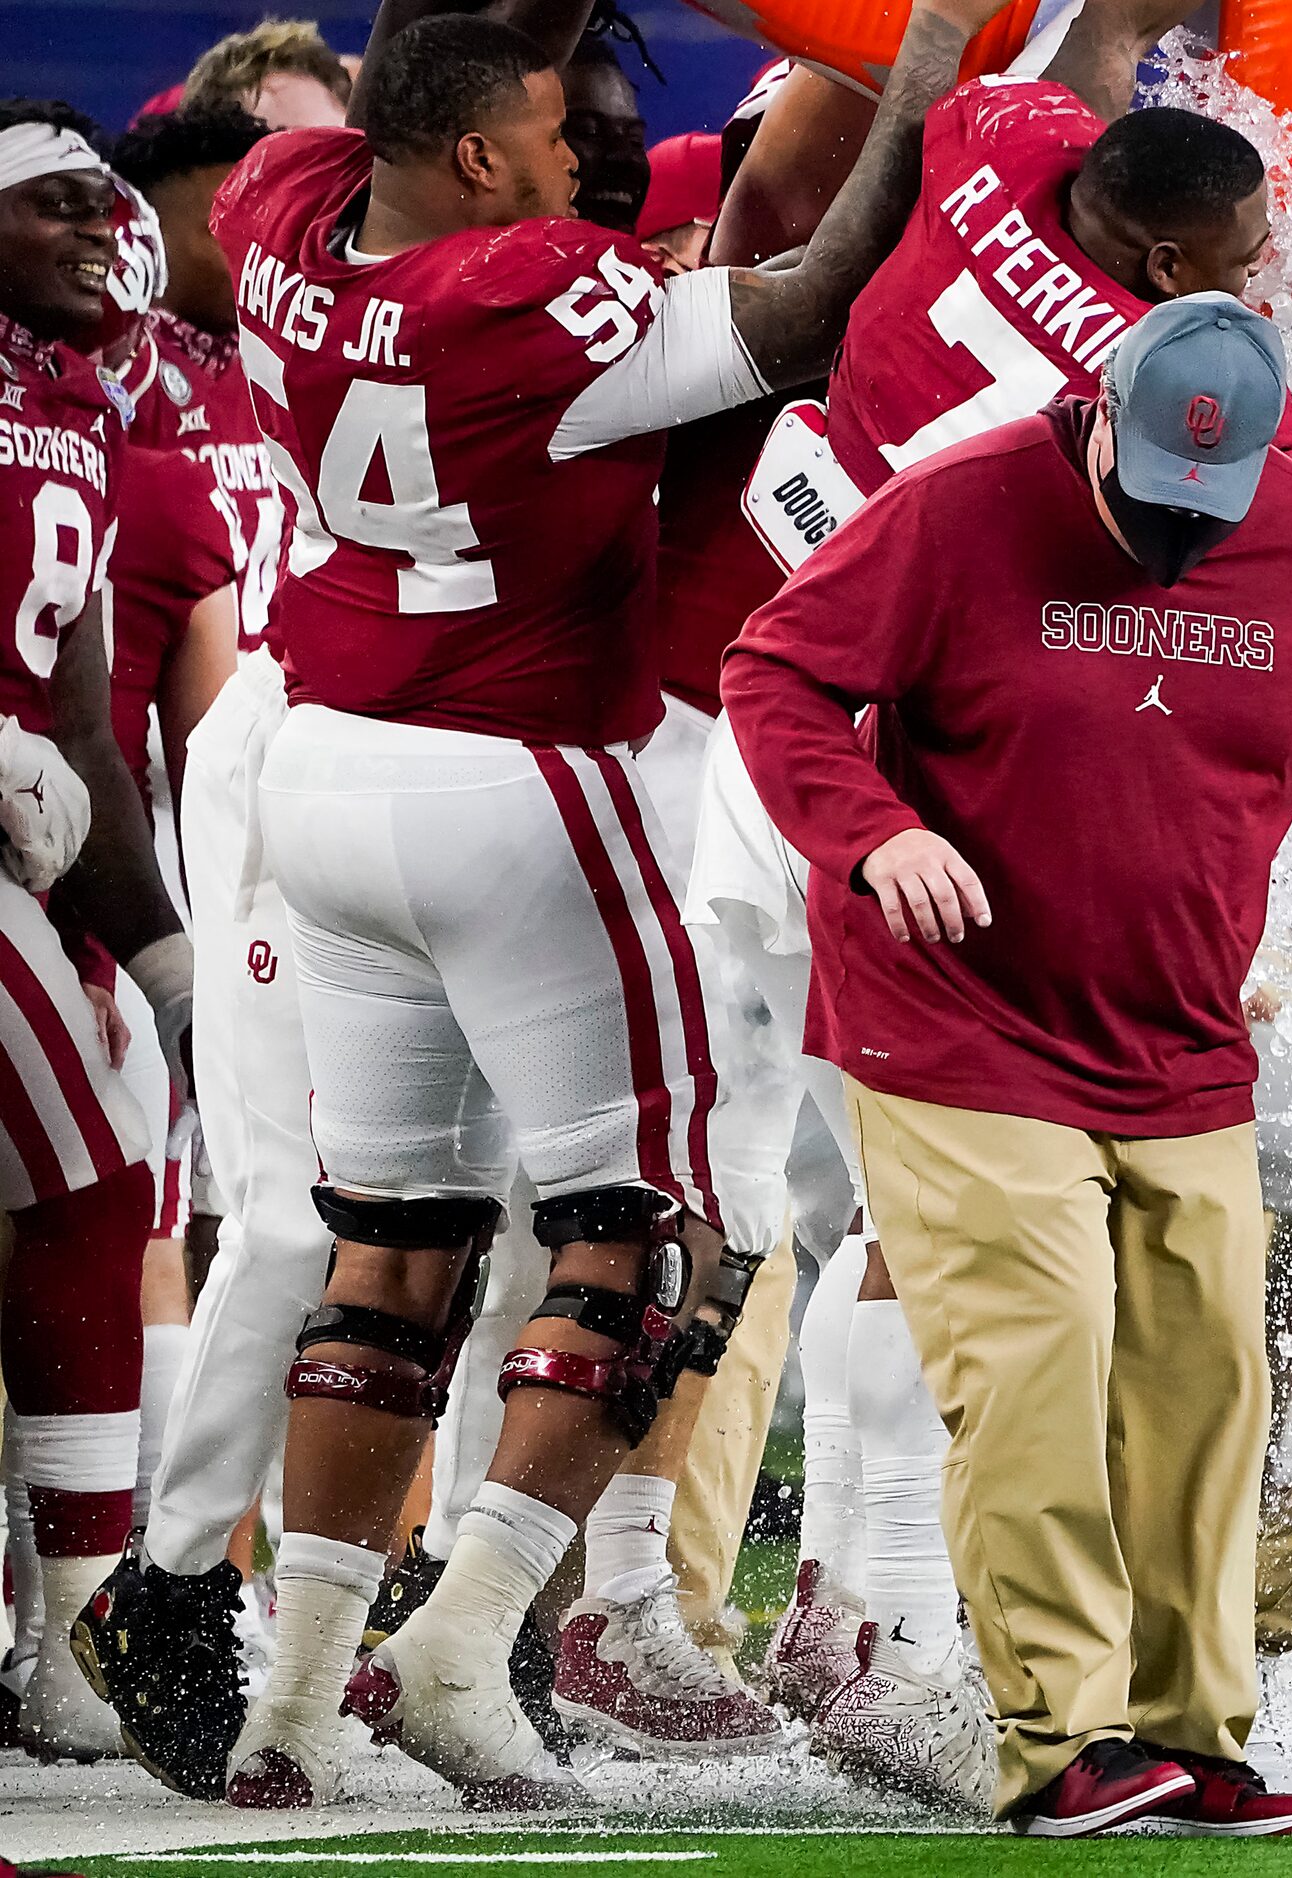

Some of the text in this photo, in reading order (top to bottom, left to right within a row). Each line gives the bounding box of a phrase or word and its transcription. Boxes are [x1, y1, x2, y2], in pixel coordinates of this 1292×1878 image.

[941, 164, 1001, 237] R.
[238, 241, 335, 351] HAYES
[342, 297, 411, 367] JR.
[543, 243, 666, 363] 54
[878, 267, 1070, 474] 7
[0, 418, 107, 499] SOONERS
[1186, 394, 1226, 449] OU
[180, 443, 273, 492] OONER
[238, 321, 499, 614] 54
[772, 472, 837, 551] DOUG
[1041, 600, 1275, 671] SOONERS
[247, 939, 278, 984] OU
[860, 1047, 890, 1060] DRI-FIT
